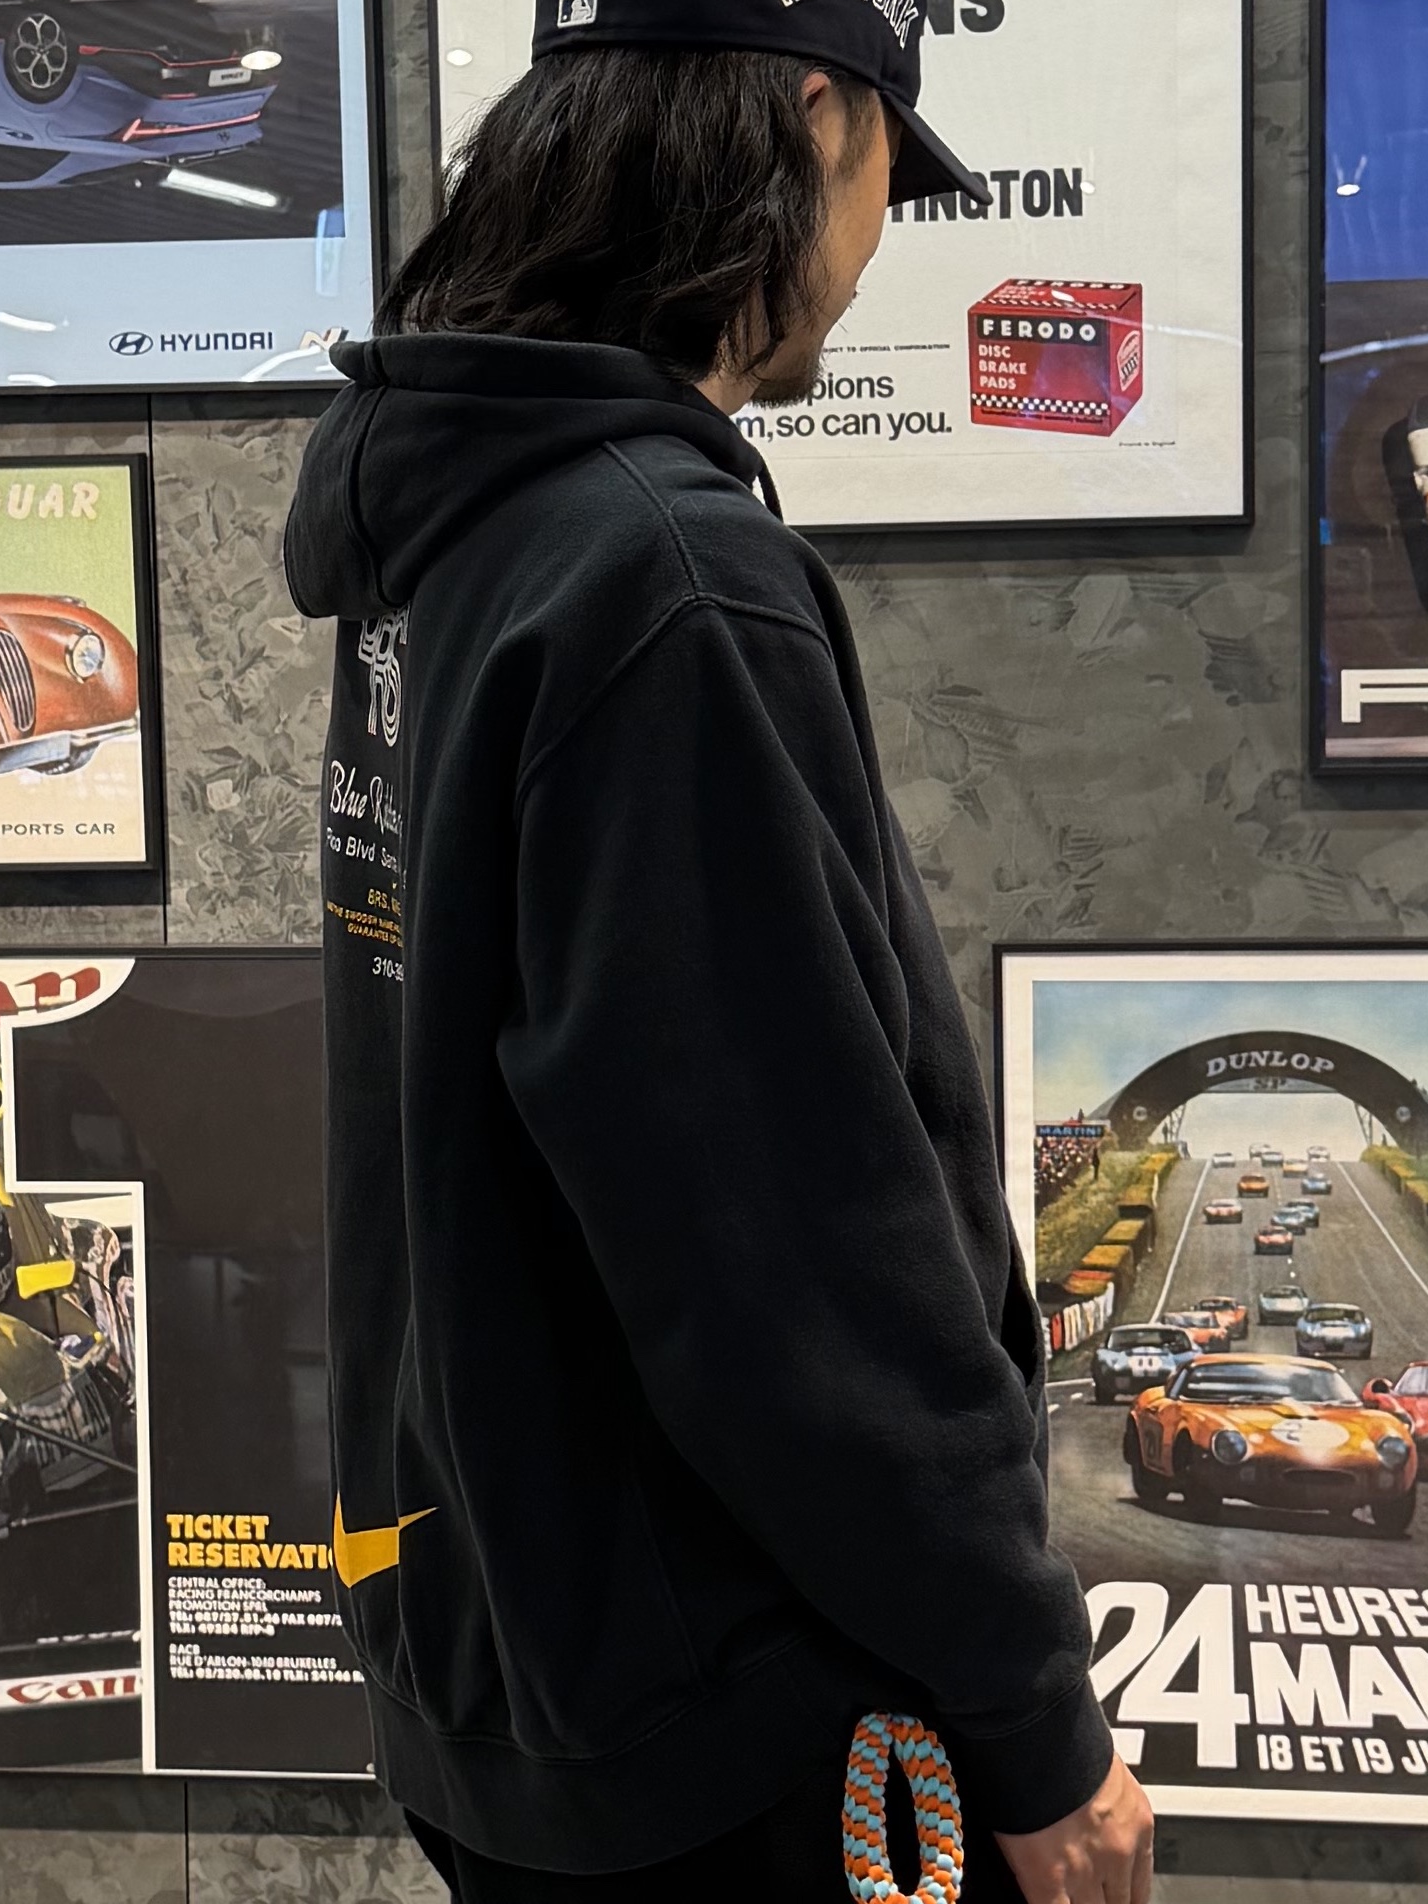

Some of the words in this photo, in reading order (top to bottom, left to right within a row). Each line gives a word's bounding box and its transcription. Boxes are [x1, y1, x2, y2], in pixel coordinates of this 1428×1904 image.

[982, 318, 1096, 342] FERODO
[160, 331, 273, 352] HYUNDAI
[978, 344, 1012, 358] DISC
[978, 359, 1027, 375] BRAKE
[979, 375, 1017, 390] PADS
[821, 412, 881, 436] can
[887, 411, 953, 441] you.
[330, 760, 368, 819] Blue
[74, 821, 116, 836] CAR
[345, 835, 376, 862] Blvd
[1207, 1049, 1335, 1078] DUNLOP
[1038, 1125, 1102, 1136] MARTINI
[166, 1514, 270, 1540] TICKET
[168, 1542, 334, 1570] RESERVATI
[168, 1577, 219, 1589] CENTRAL
[168, 1588, 215, 1600] RACING
[217, 1589, 322, 1604] FRANCORCHAMPS
[168, 1600, 241, 1612] PROMOTION
[276, 1657, 338, 1670] BRUXELLES
[1083, 1581, 1251, 1769] 24
[1257, 1734, 1294, 1770] 18
[1300, 1735, 1345, 1773] ET
[1352, 1737, 1394, 1774] 19
